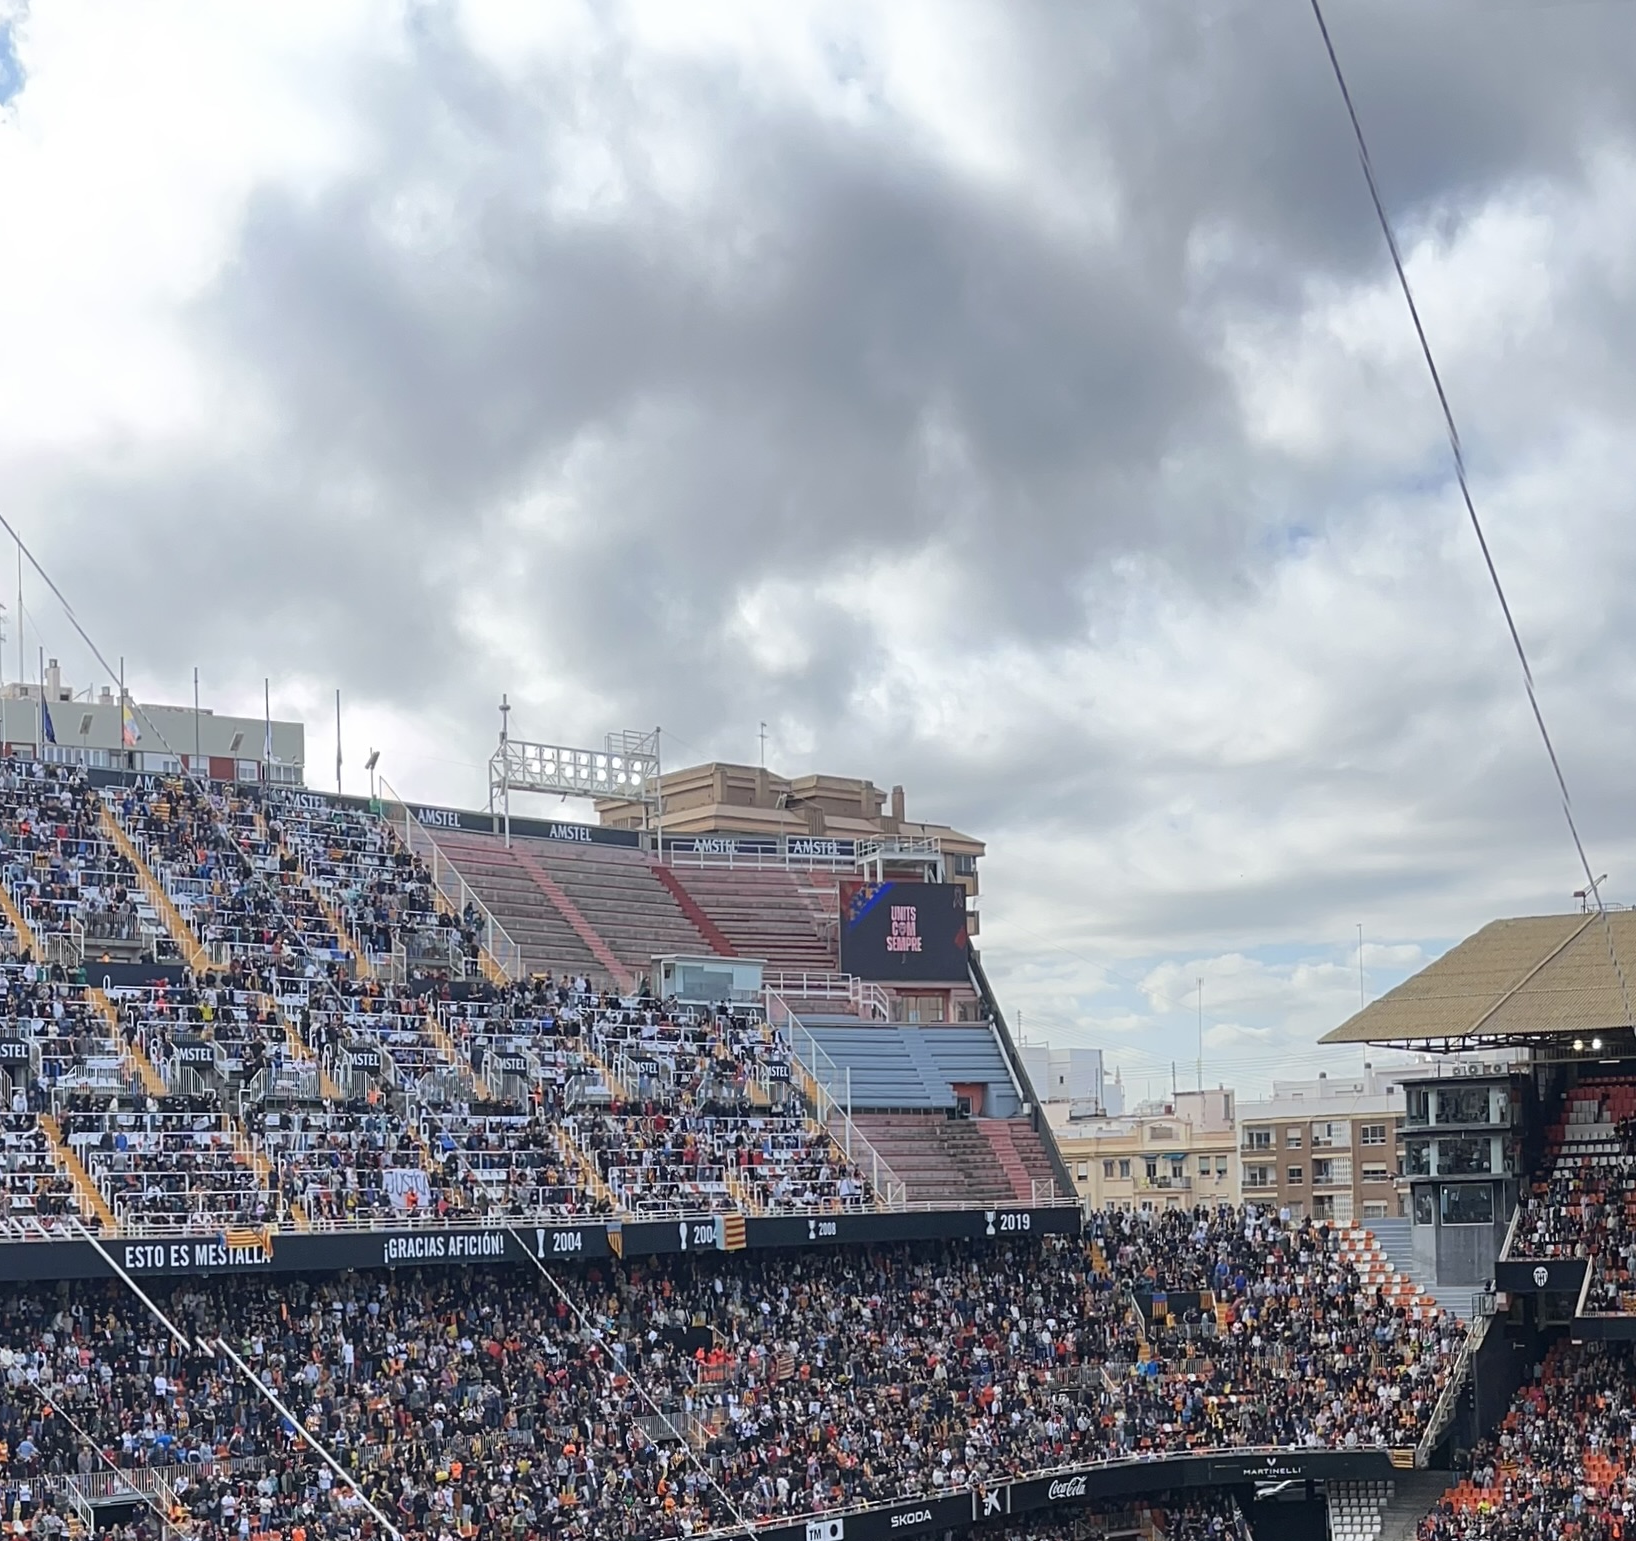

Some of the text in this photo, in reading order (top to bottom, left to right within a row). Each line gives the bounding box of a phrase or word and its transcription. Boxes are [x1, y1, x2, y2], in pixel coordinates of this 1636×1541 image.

[417, 809, 460, 828] AMSTEL
[549, 822, 591, 842] AMSTEL
[692, 839, 738, 853] AMSTEL
[793, 839, 840, 856] AMSTEL
[891, 905, 916, 922] UNITS
[886, 936, 922, 952] SEMPRE
[1000, 1213, 1031, 1235] 2019
[384, 1229, 506, 1262] ¡GRACIAS AFICIÓN!
[552, 1231, 582, 1252] 2004
[125, 1246, 165, 1269] ESTO
[170, 1245, 190, 1267] ES
[1242, 1466, 1302, 1476] MARTINELLI
[808, 1529, 822, 1541] TM
